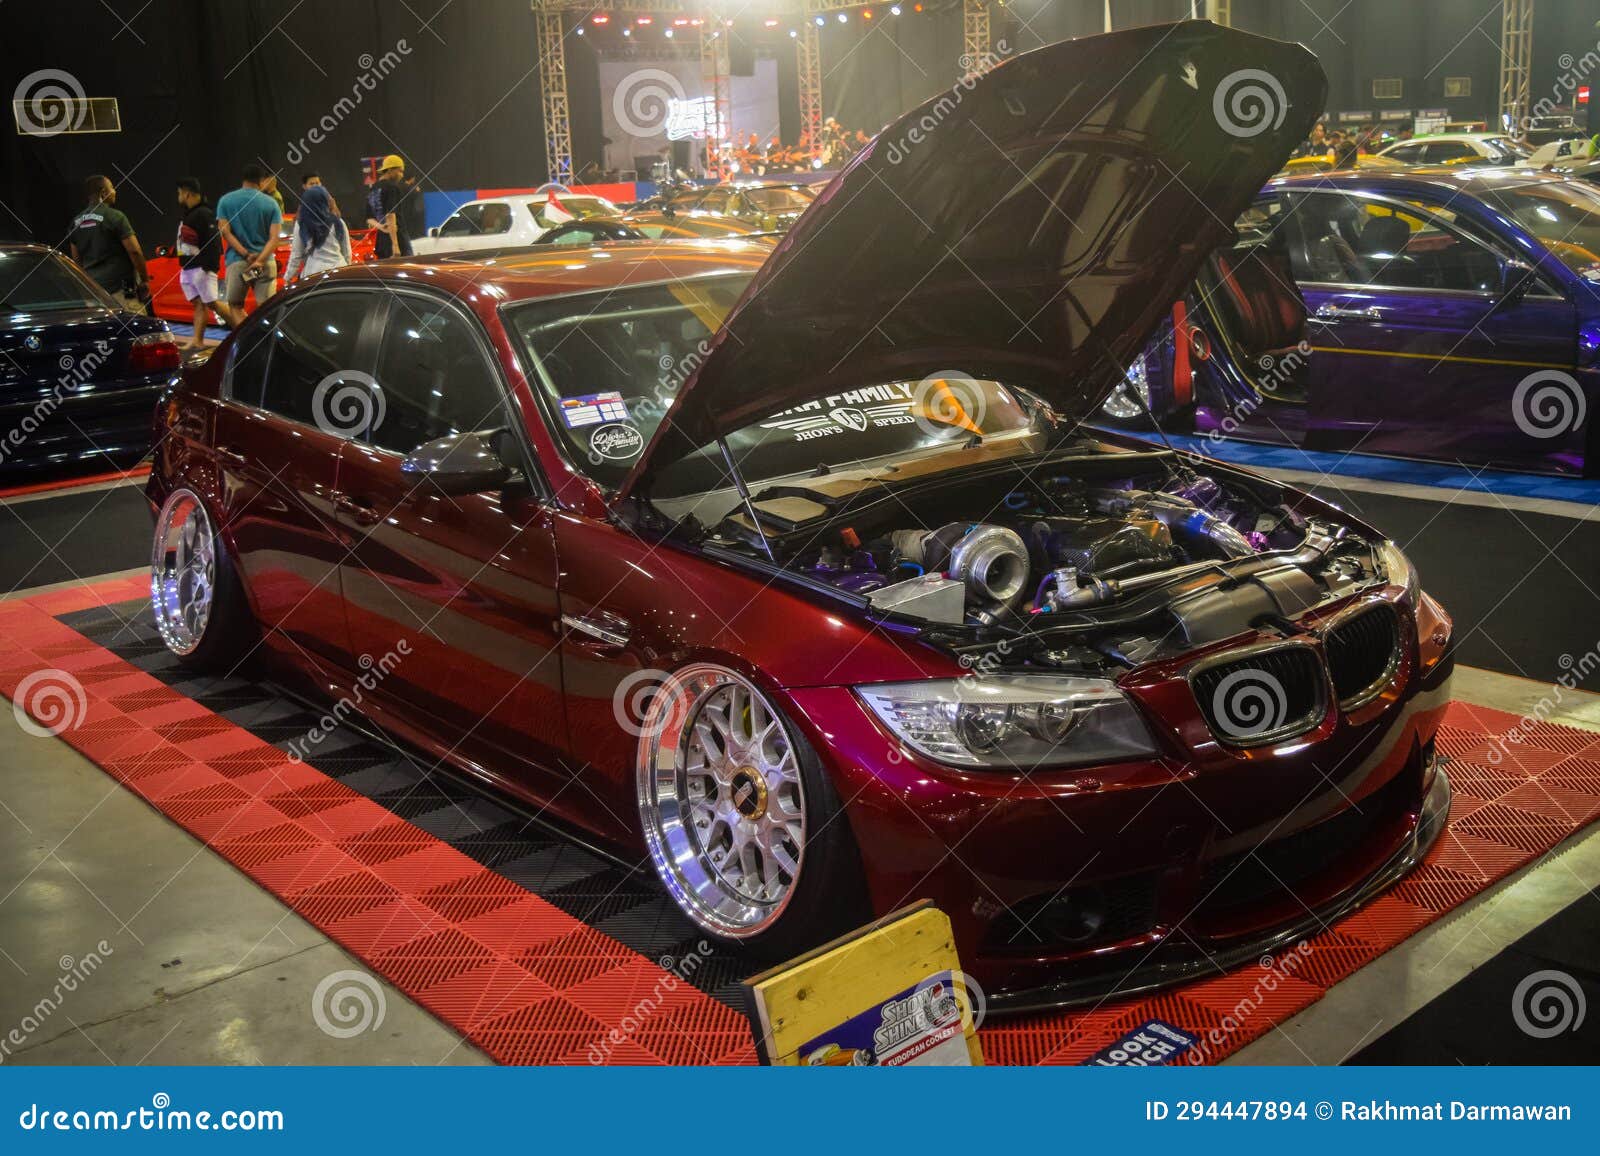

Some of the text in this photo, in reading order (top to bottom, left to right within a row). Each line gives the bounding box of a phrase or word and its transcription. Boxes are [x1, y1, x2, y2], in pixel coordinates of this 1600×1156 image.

[794, 415, 916, 442] JHON'S SPEED
[882, 986, 934, 1026] SHOW
[887, 1027, 955, 1066] EUROPEAN COOLEST
